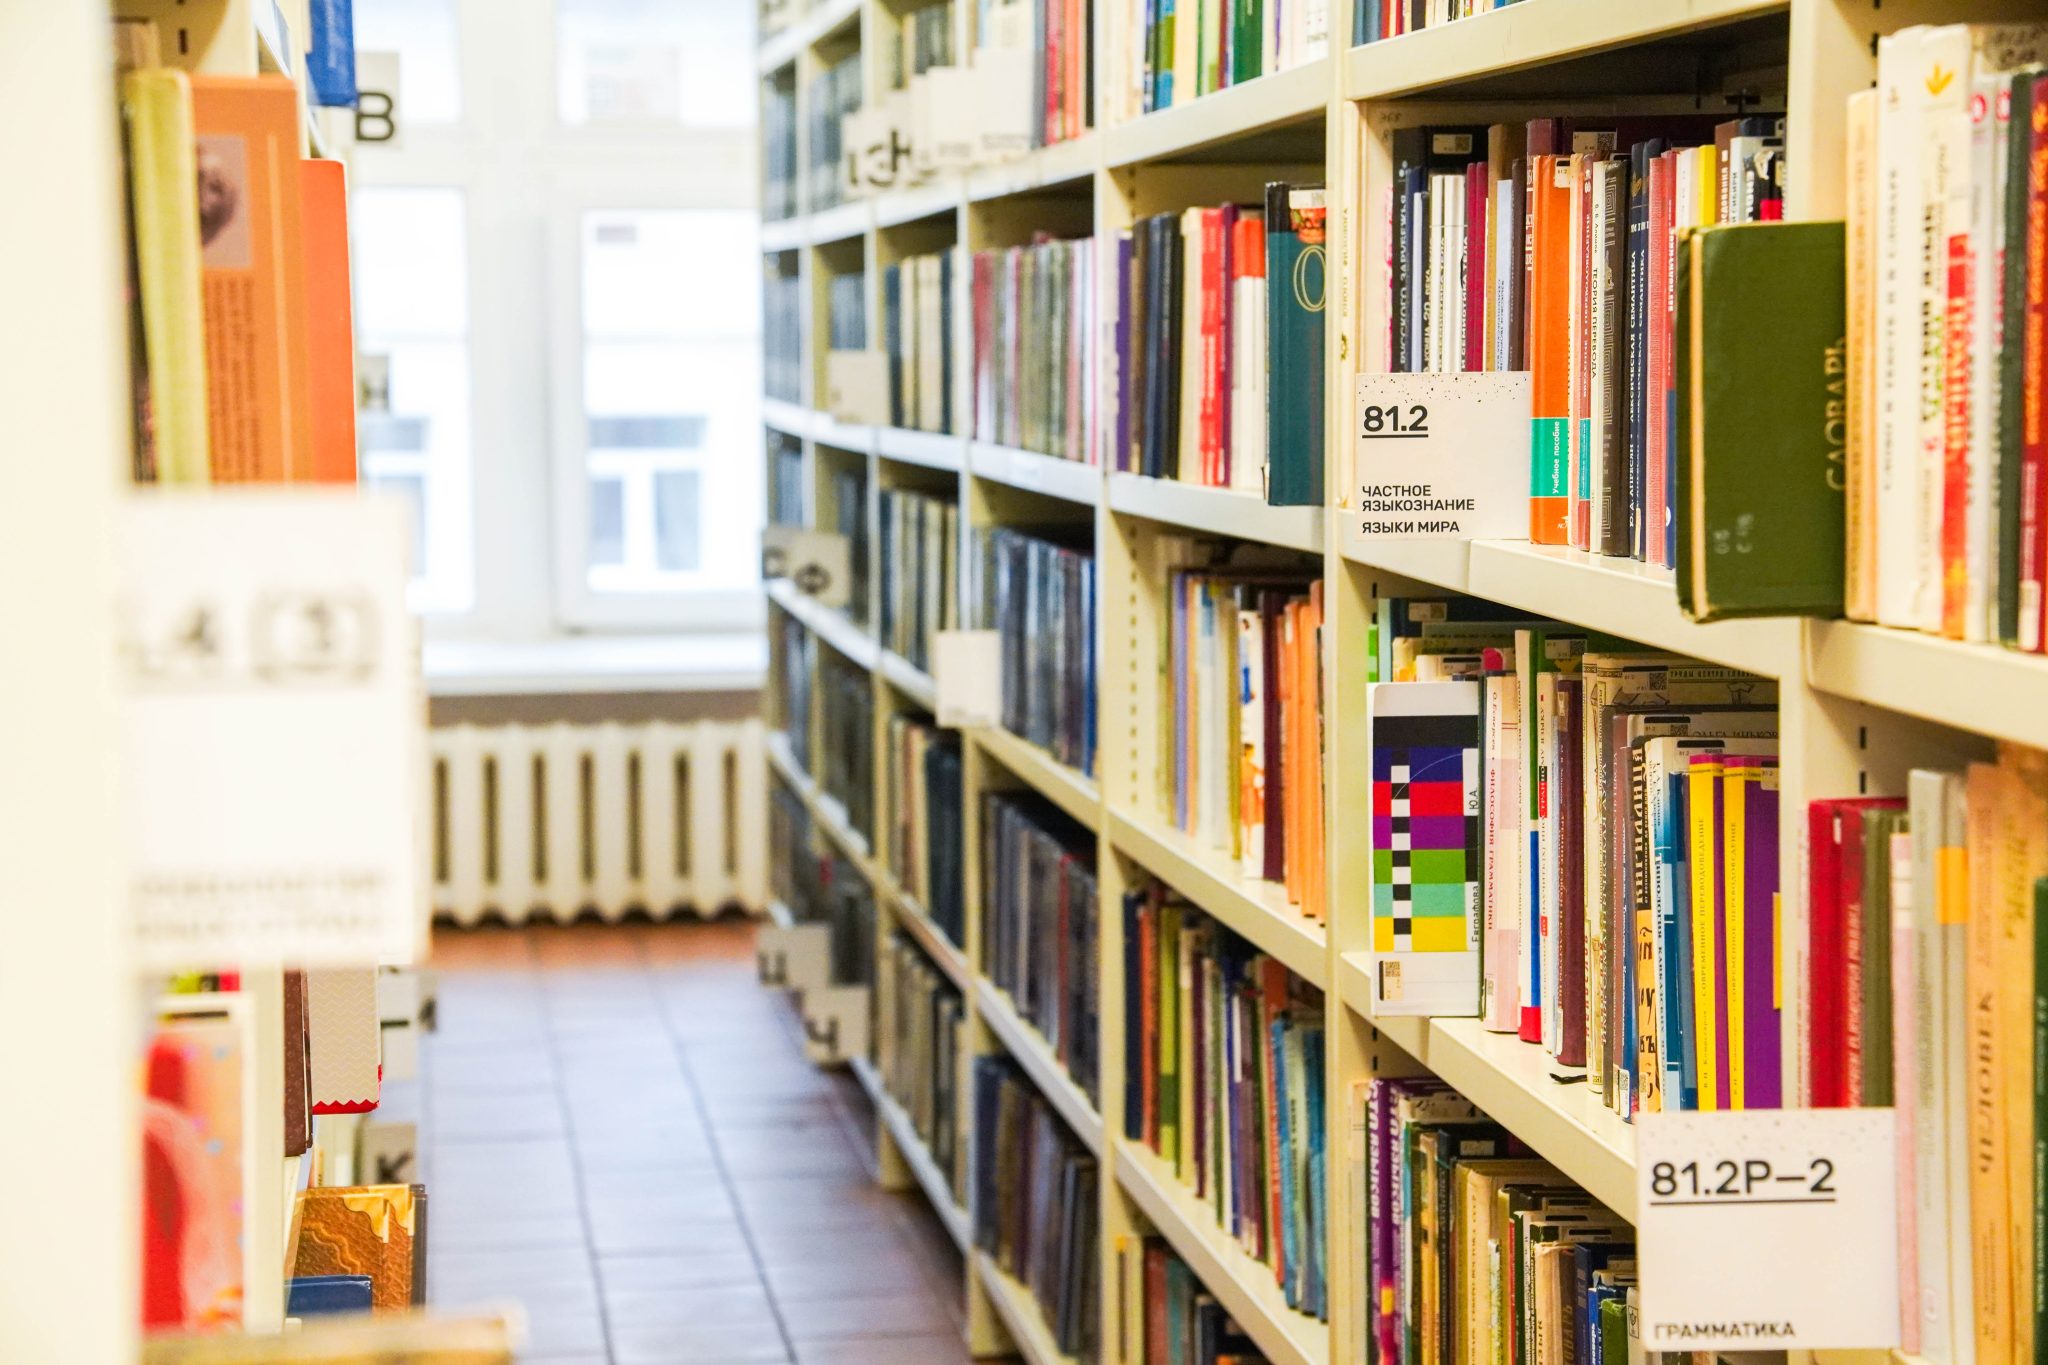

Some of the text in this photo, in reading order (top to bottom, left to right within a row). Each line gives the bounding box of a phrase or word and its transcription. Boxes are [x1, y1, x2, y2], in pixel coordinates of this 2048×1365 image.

[356, 92, 396, 141] В
[1363, 405, 1429, 432] 81.2
[1825, 337, 1846, 491] СЛОВАРЬ
[1551, 421, 1561, 494] Учебное пособие
[1362, 485, 1432, 498] ЧАСТНОЕ
[1362, 499, 1476, 512] ЯЗЫКОЗНАНИЕ
[1362, 521, 1461, 534] ЯЗЫКИ МИРА
[1487, 849, 1495, 931] ГРАММАТИКИ
[1698, 817, 1706, 916] ПЕРЕВОДОВЕДЕНИЕ
[1471, 886, 1479, 943] Евграфова
[1655, 853, 1663, 938] ТИПОЛОГИЯ
[1658, 947, 1666, 1033] КАВКАЗСКИХ
[1653, 1321, 1797, 1340] ГРАММАТИКА
